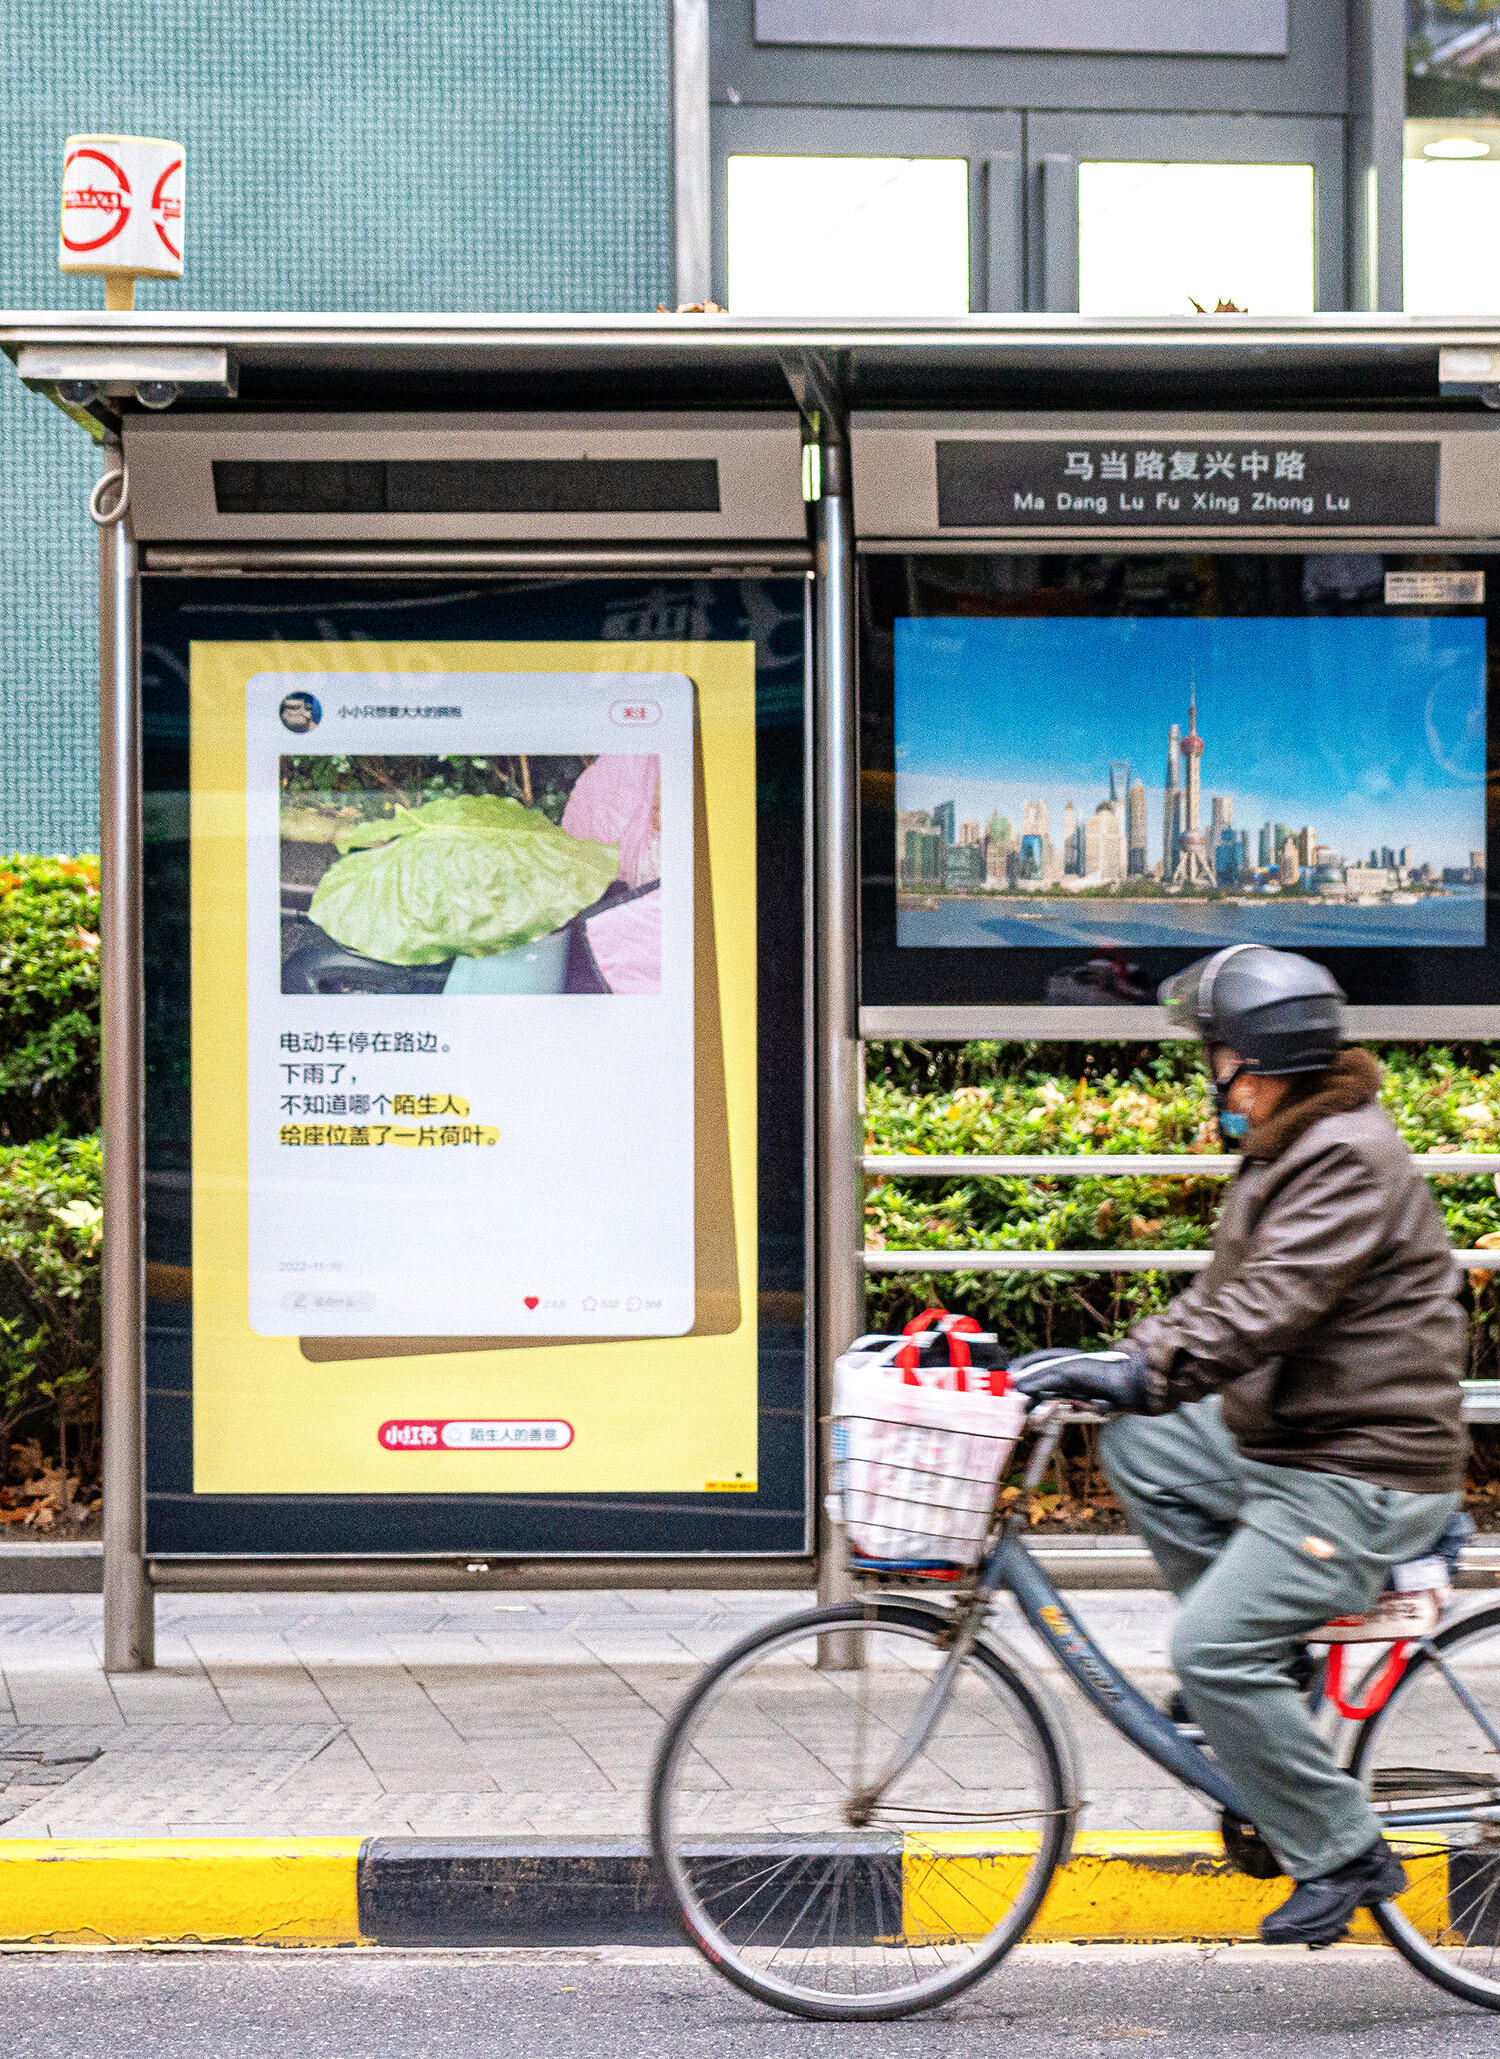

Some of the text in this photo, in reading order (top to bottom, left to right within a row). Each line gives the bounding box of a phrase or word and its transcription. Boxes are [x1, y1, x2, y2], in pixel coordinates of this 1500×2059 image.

[1064, 450, 1306, 481] 马当路复兴中路
[1013, 492, 1351, 514] Ma Dang Lu Fu Xing Zhong Lu
[279, 1030, 450, 1053] 电动车停在路边。
[279, 1125, 497, 1147] 给座位盖了一片荷叶。
[385, 1424, 558, 1446] 小红书 陌生人的善意
